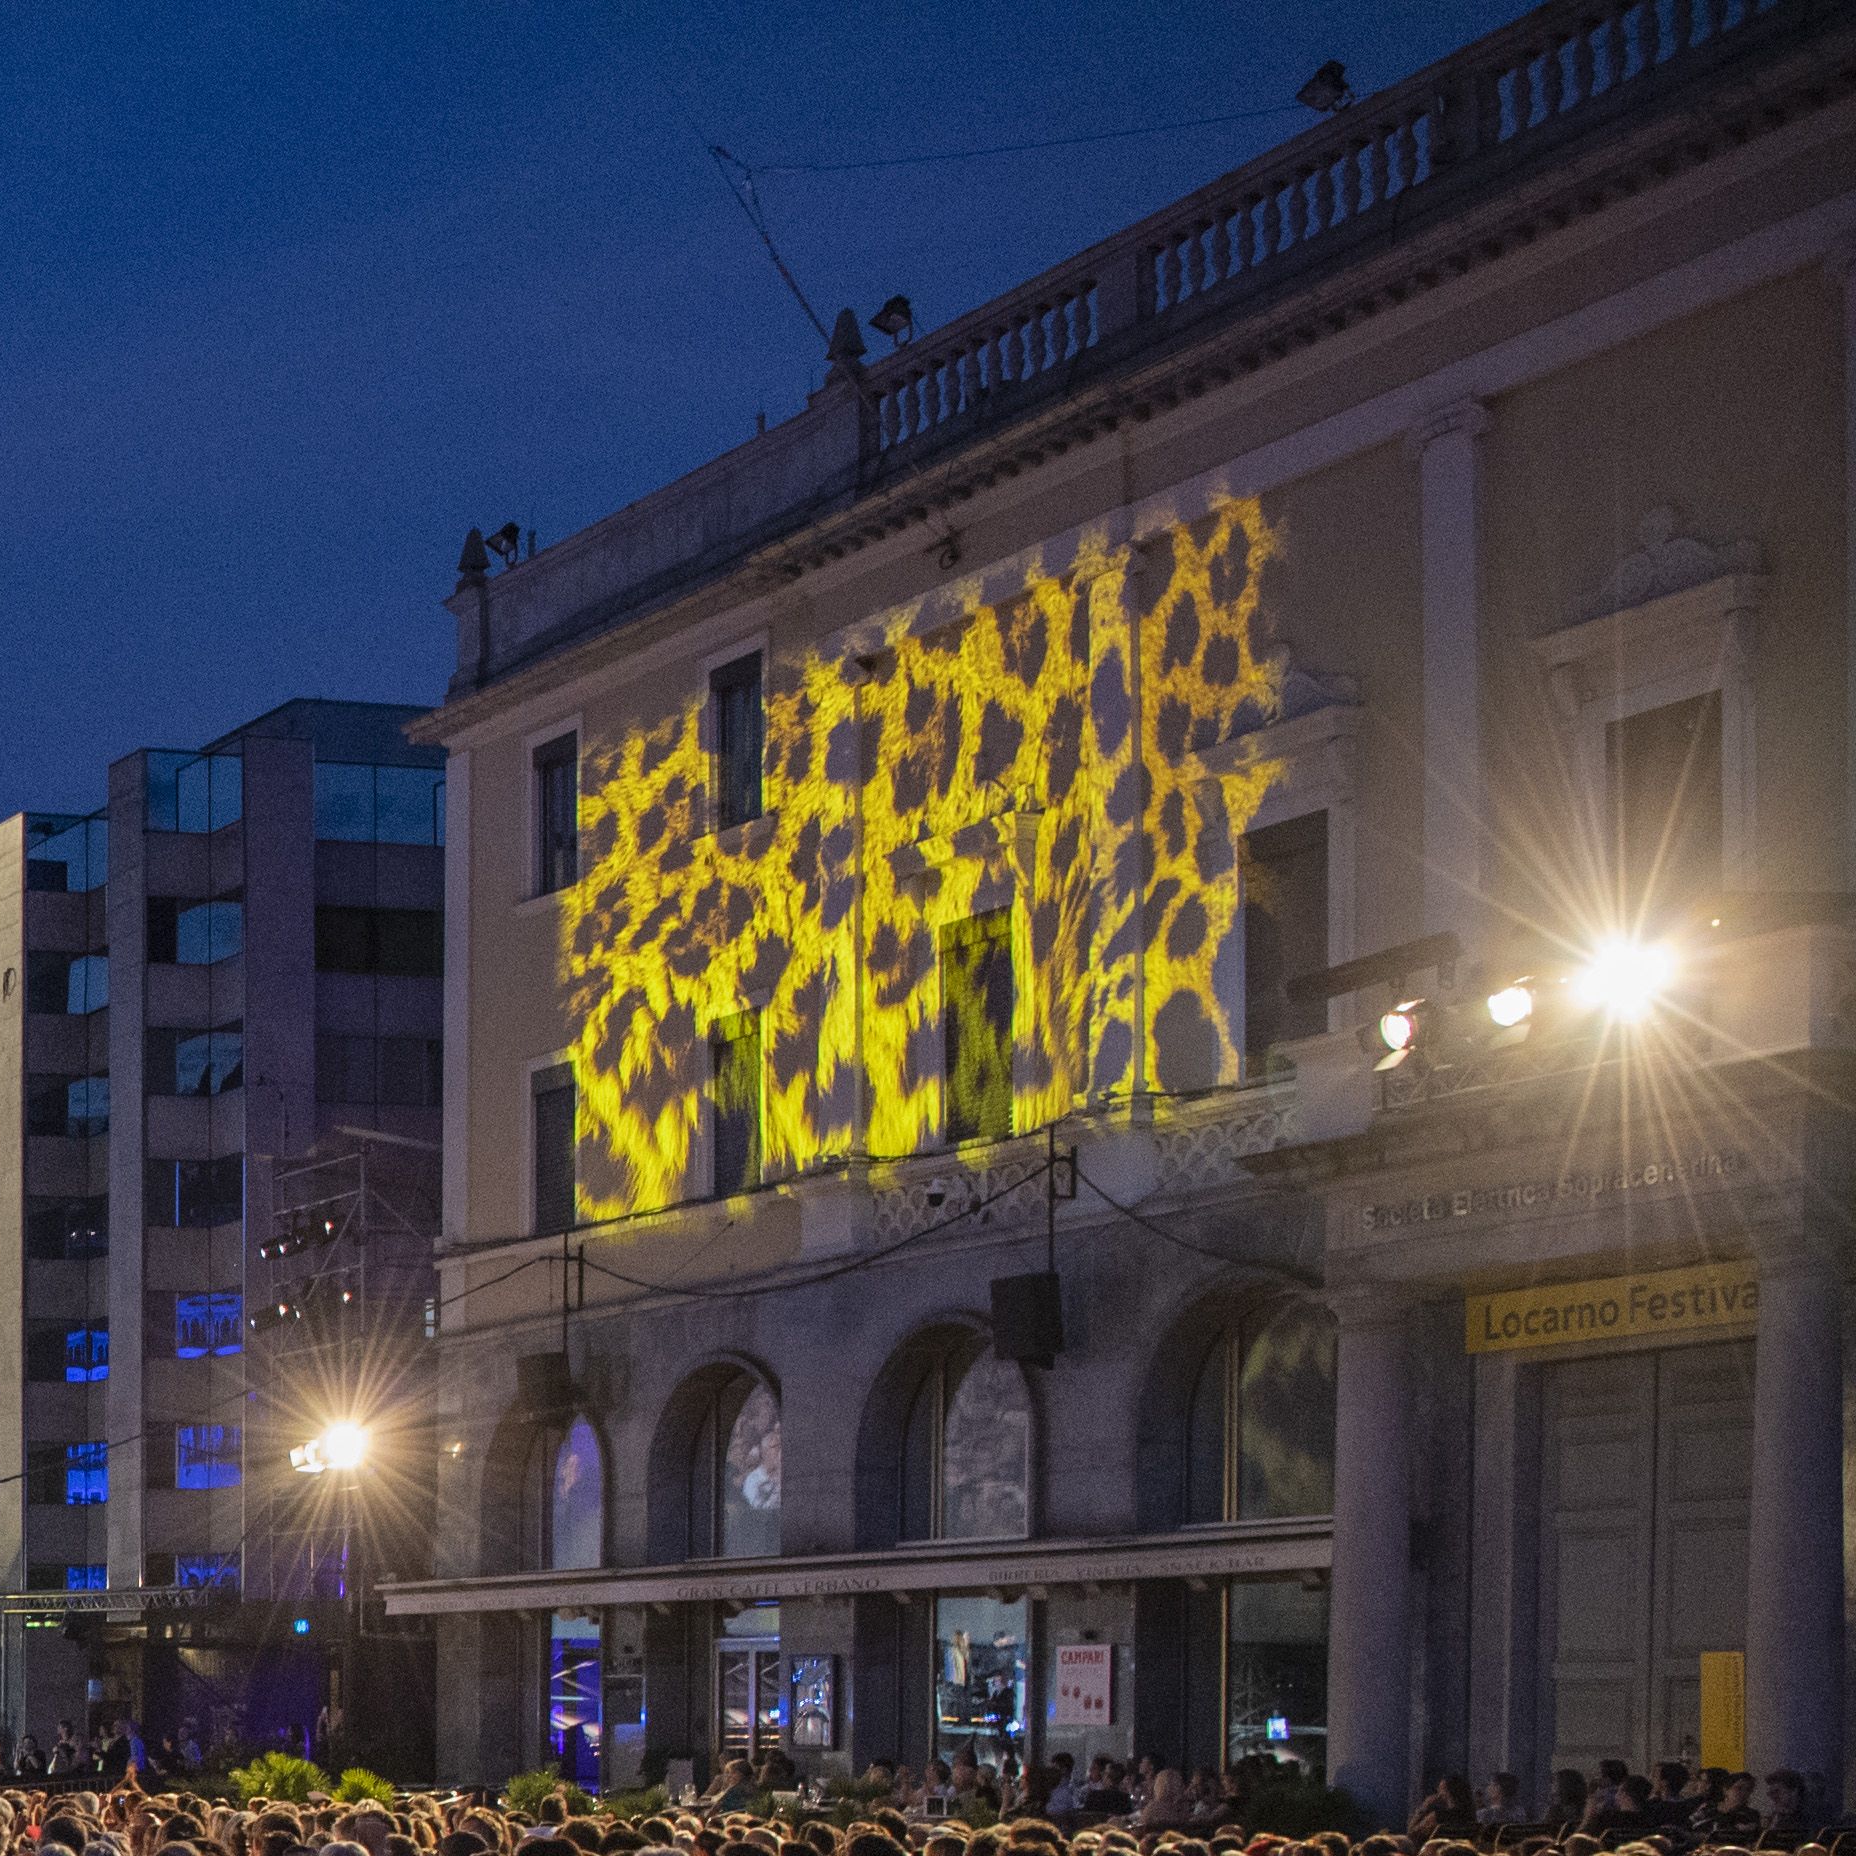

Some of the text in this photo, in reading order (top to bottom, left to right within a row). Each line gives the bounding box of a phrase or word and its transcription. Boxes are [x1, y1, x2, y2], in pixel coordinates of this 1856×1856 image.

[1484, 1277, 1759, 1342] Locarno Festiva
[677, 1586, 724, 1598] GRAN
[793, 1578, 880, 1594] VERBANO
[1061, 1651, 1104, 1664] CAMPARI
